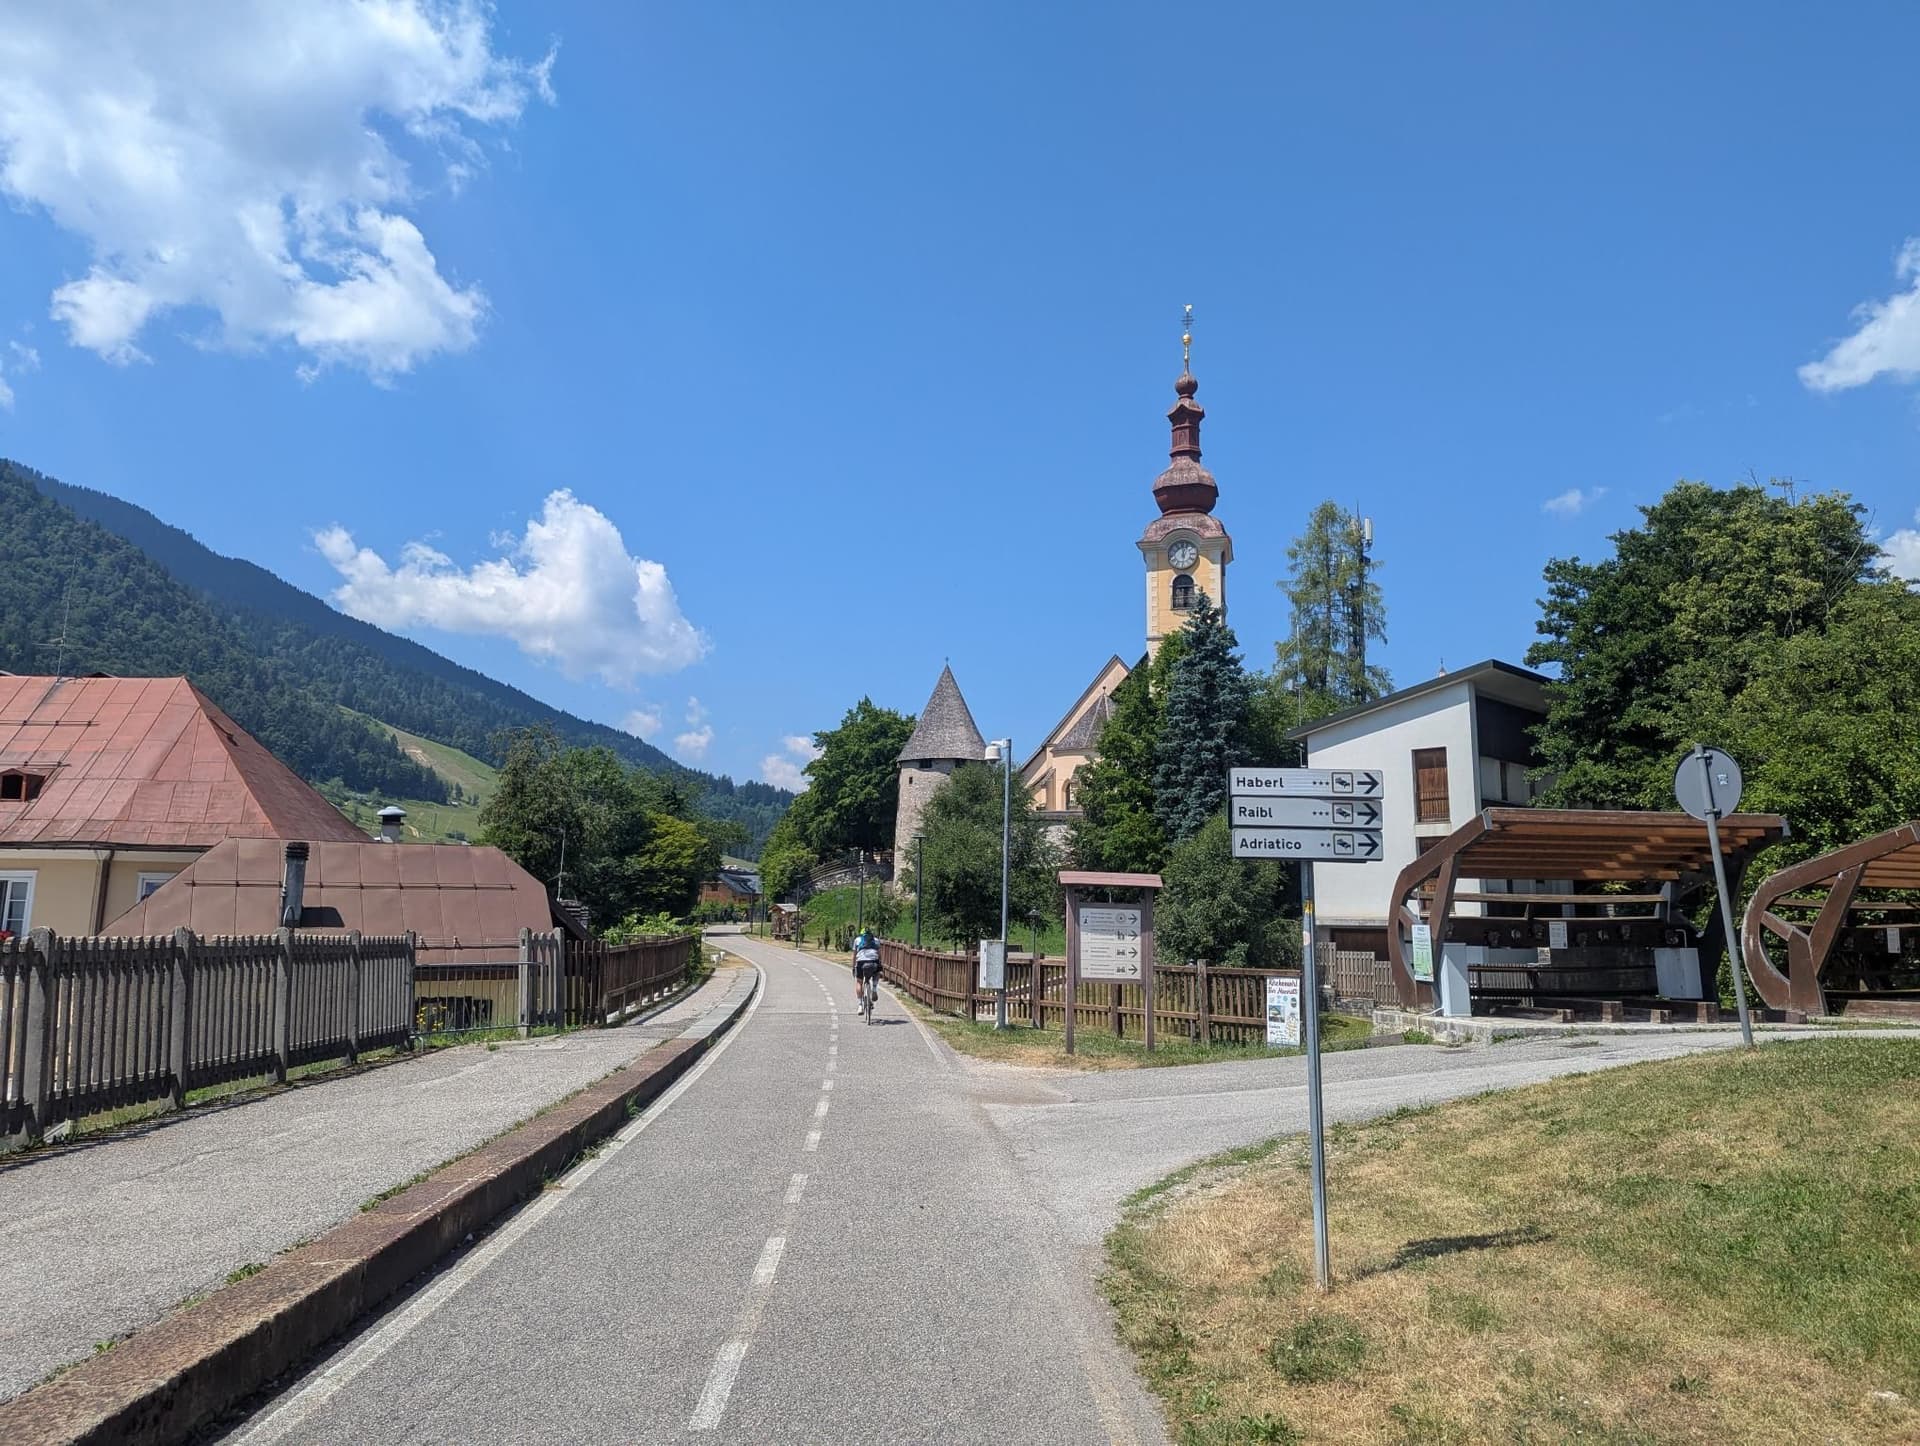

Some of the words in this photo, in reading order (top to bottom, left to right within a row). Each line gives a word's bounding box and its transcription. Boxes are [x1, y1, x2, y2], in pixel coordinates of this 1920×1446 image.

[1236, 776, 1285, 788] Haberl
[1238, 806, 1273, 818] Raibl
[1239, 838, 1302, 850] Adriatico
